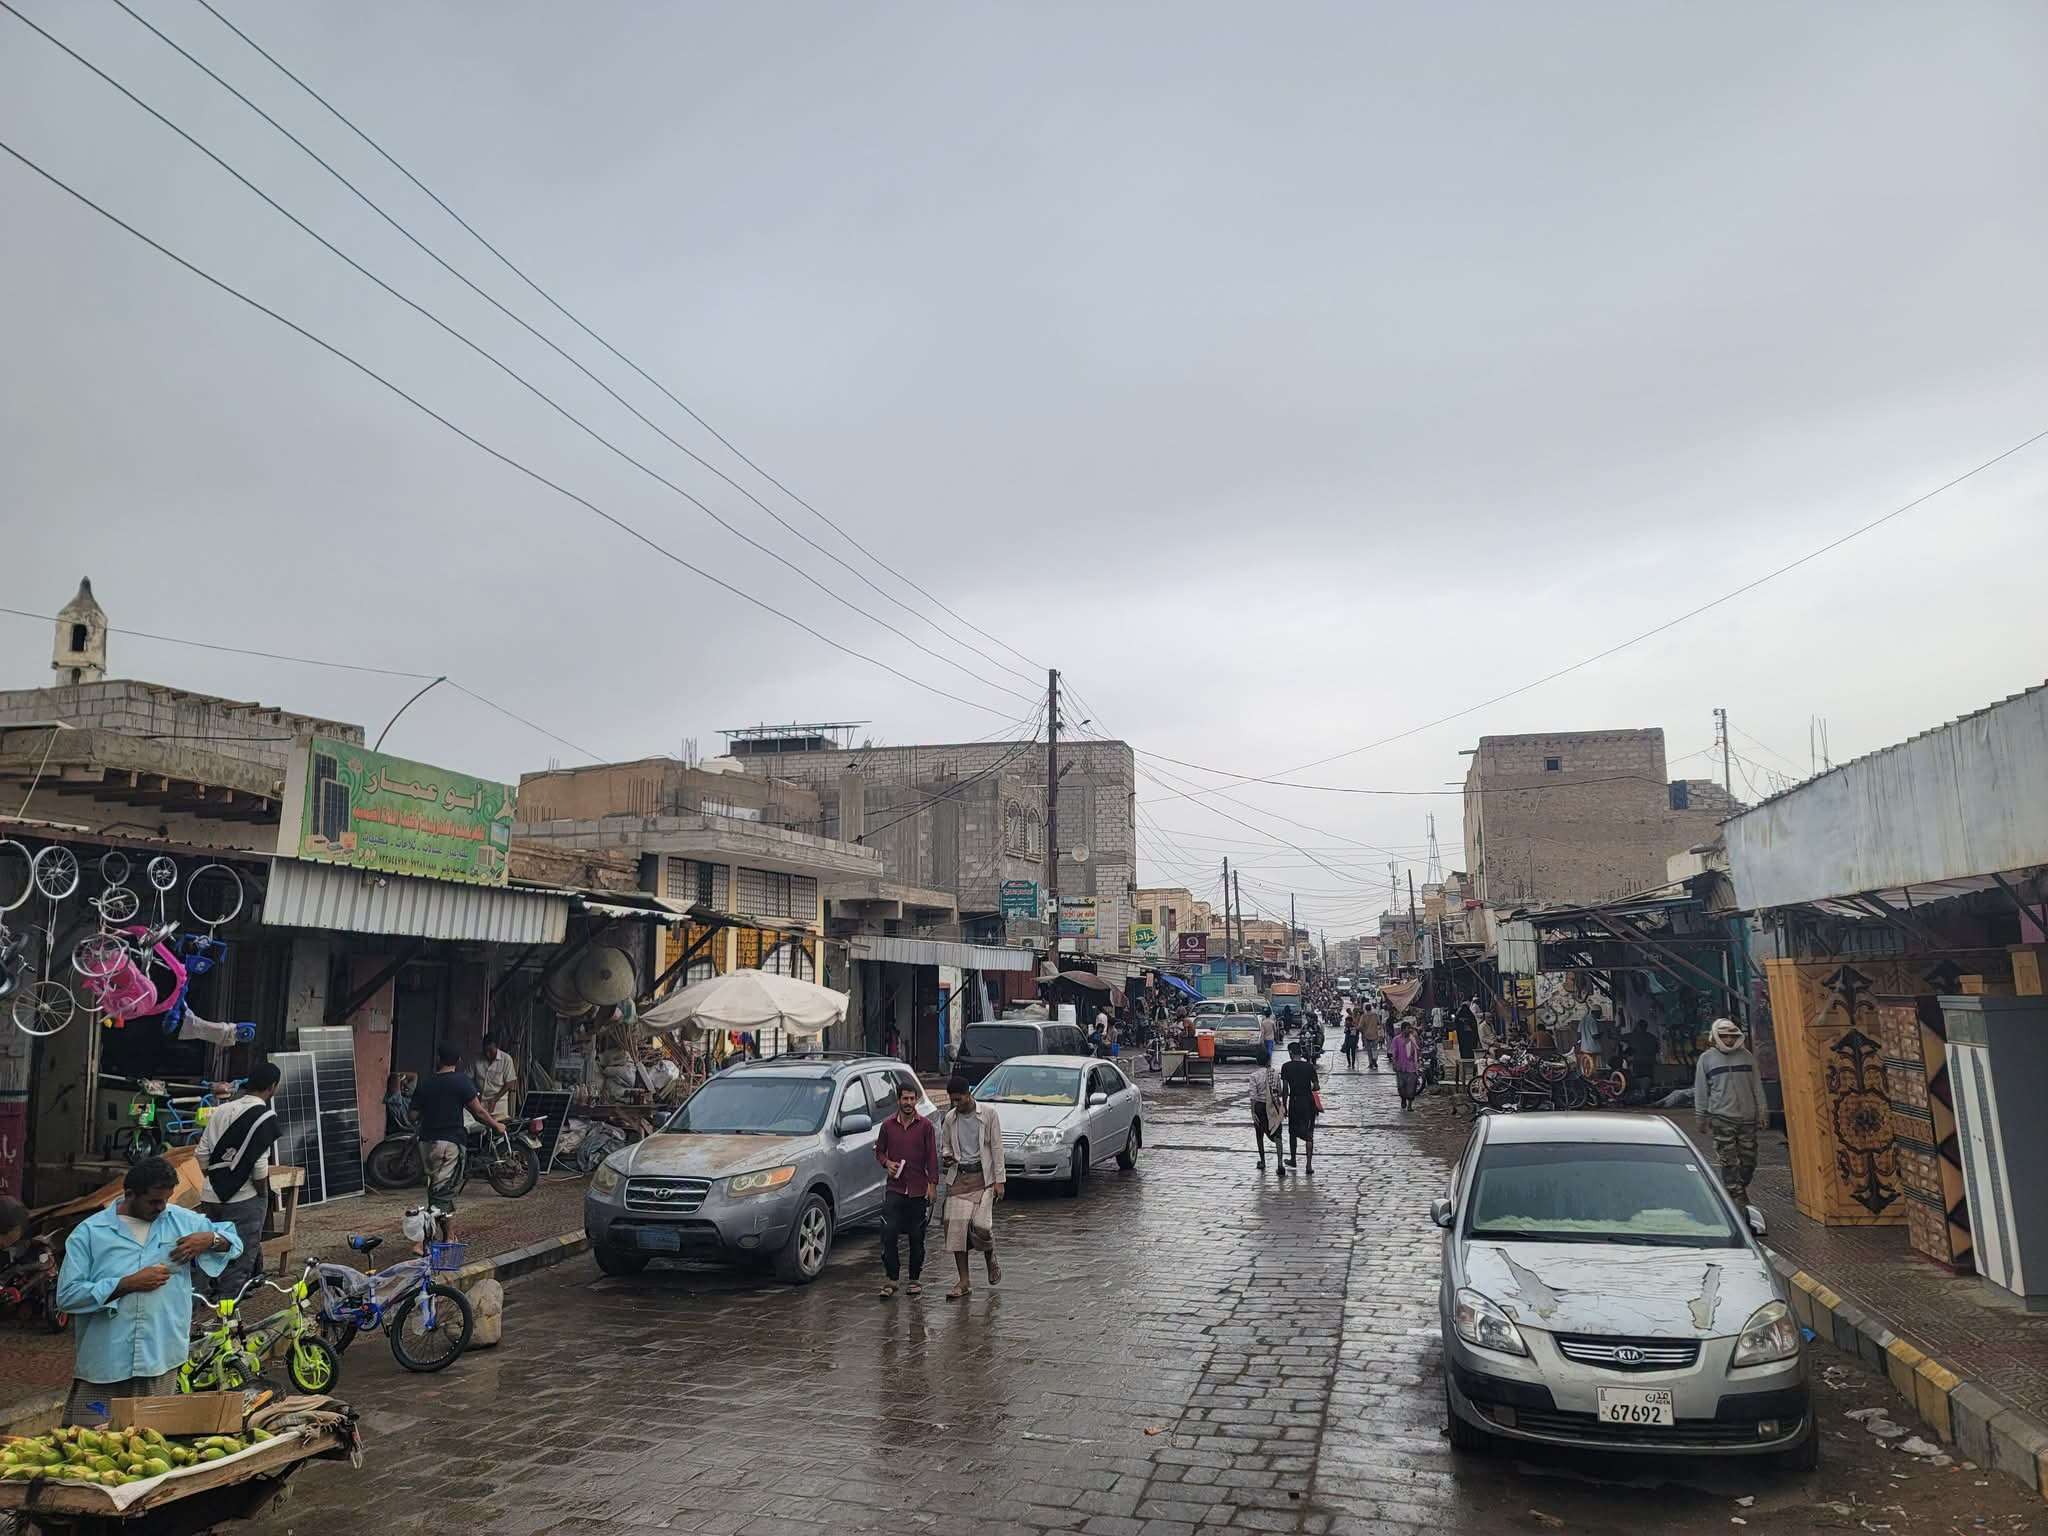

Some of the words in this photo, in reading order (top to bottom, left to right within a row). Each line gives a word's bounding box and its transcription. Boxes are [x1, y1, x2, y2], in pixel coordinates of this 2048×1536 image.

[362, 767, 438, 801] عمار
[442, 783, 483, 814] أبو
[1618, 1350, 1639, 1360] KIA
[1610, 1404, 1661, 1424] 67692
